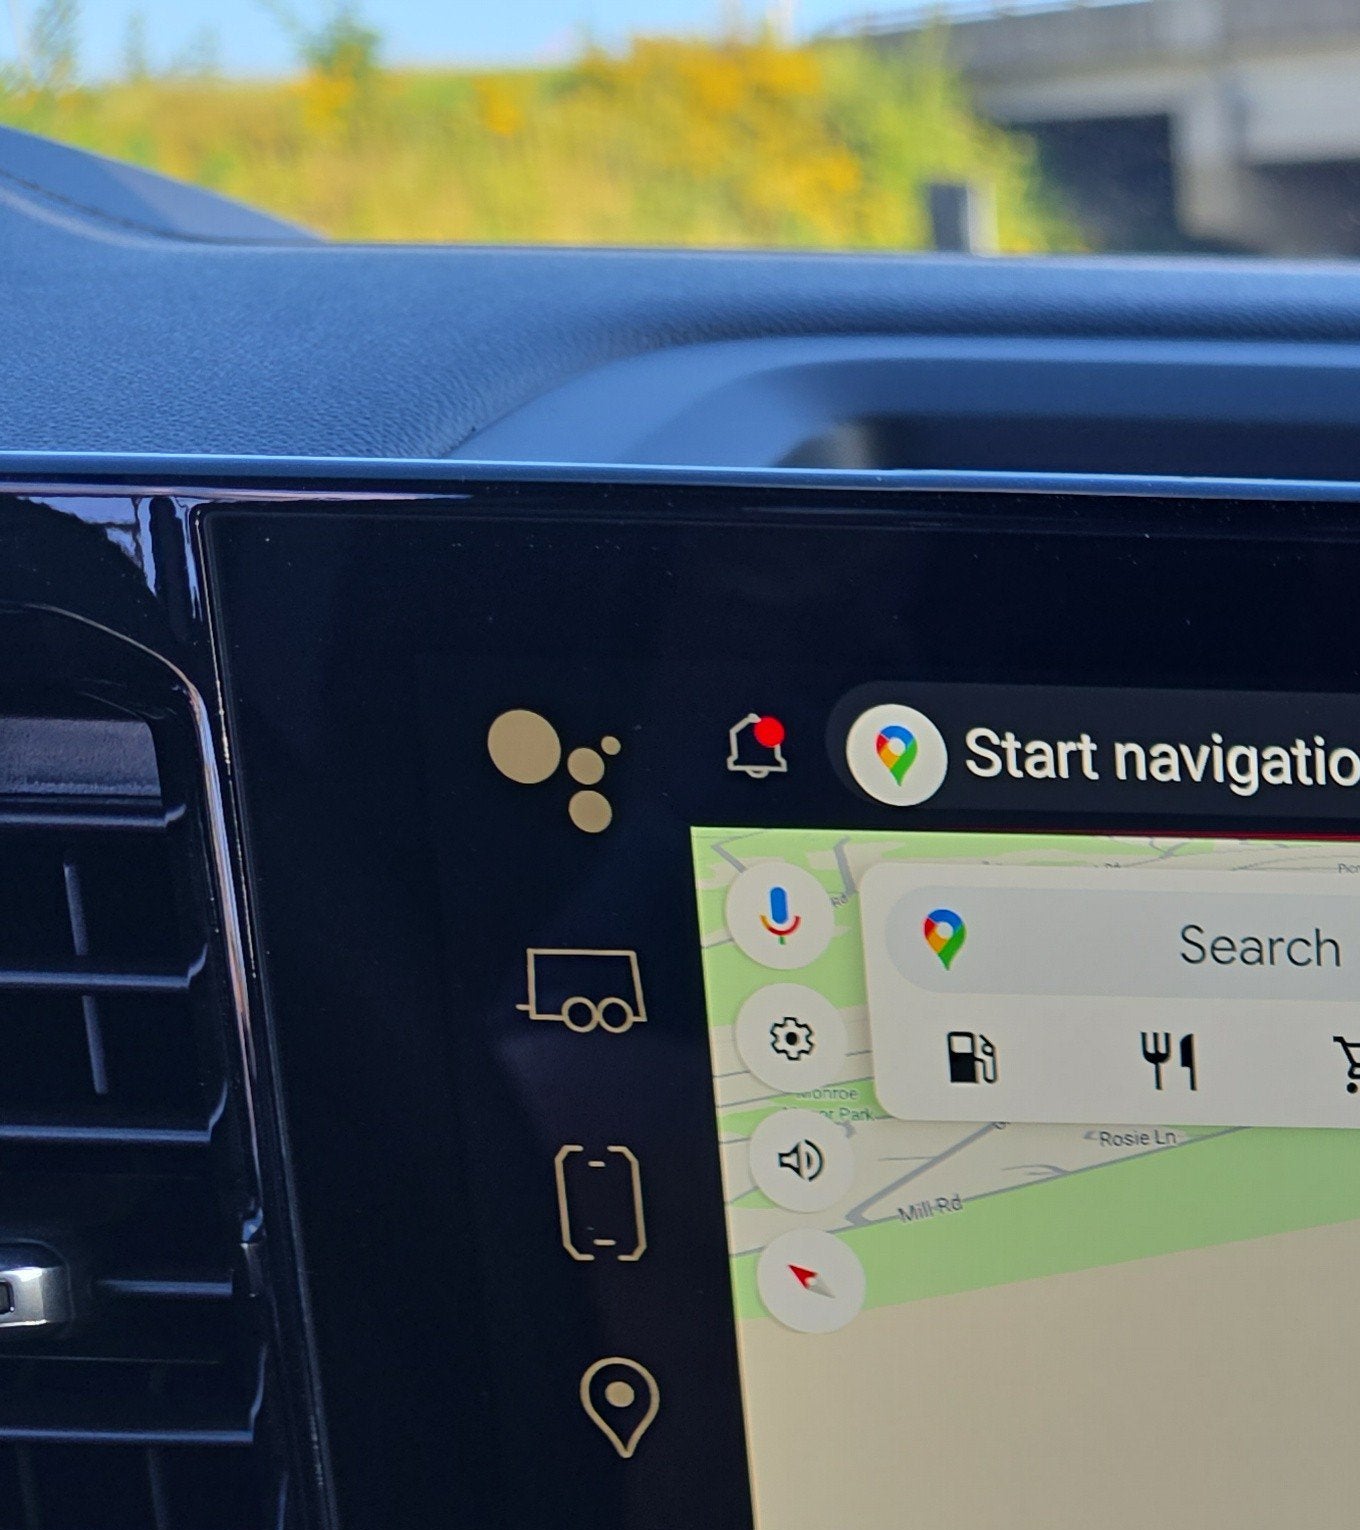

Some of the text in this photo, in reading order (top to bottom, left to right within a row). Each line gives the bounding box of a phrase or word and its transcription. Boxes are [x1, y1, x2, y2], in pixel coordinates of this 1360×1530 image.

[965, 727, 1099, 781] Start
[1181, 924, 1341, 967] Search
[839, 1107, 875, 1121] Park
[1100, 1128, 1177, 1148] Rosie Ln
[897, 1193, 964, 1224] Mill Rd
